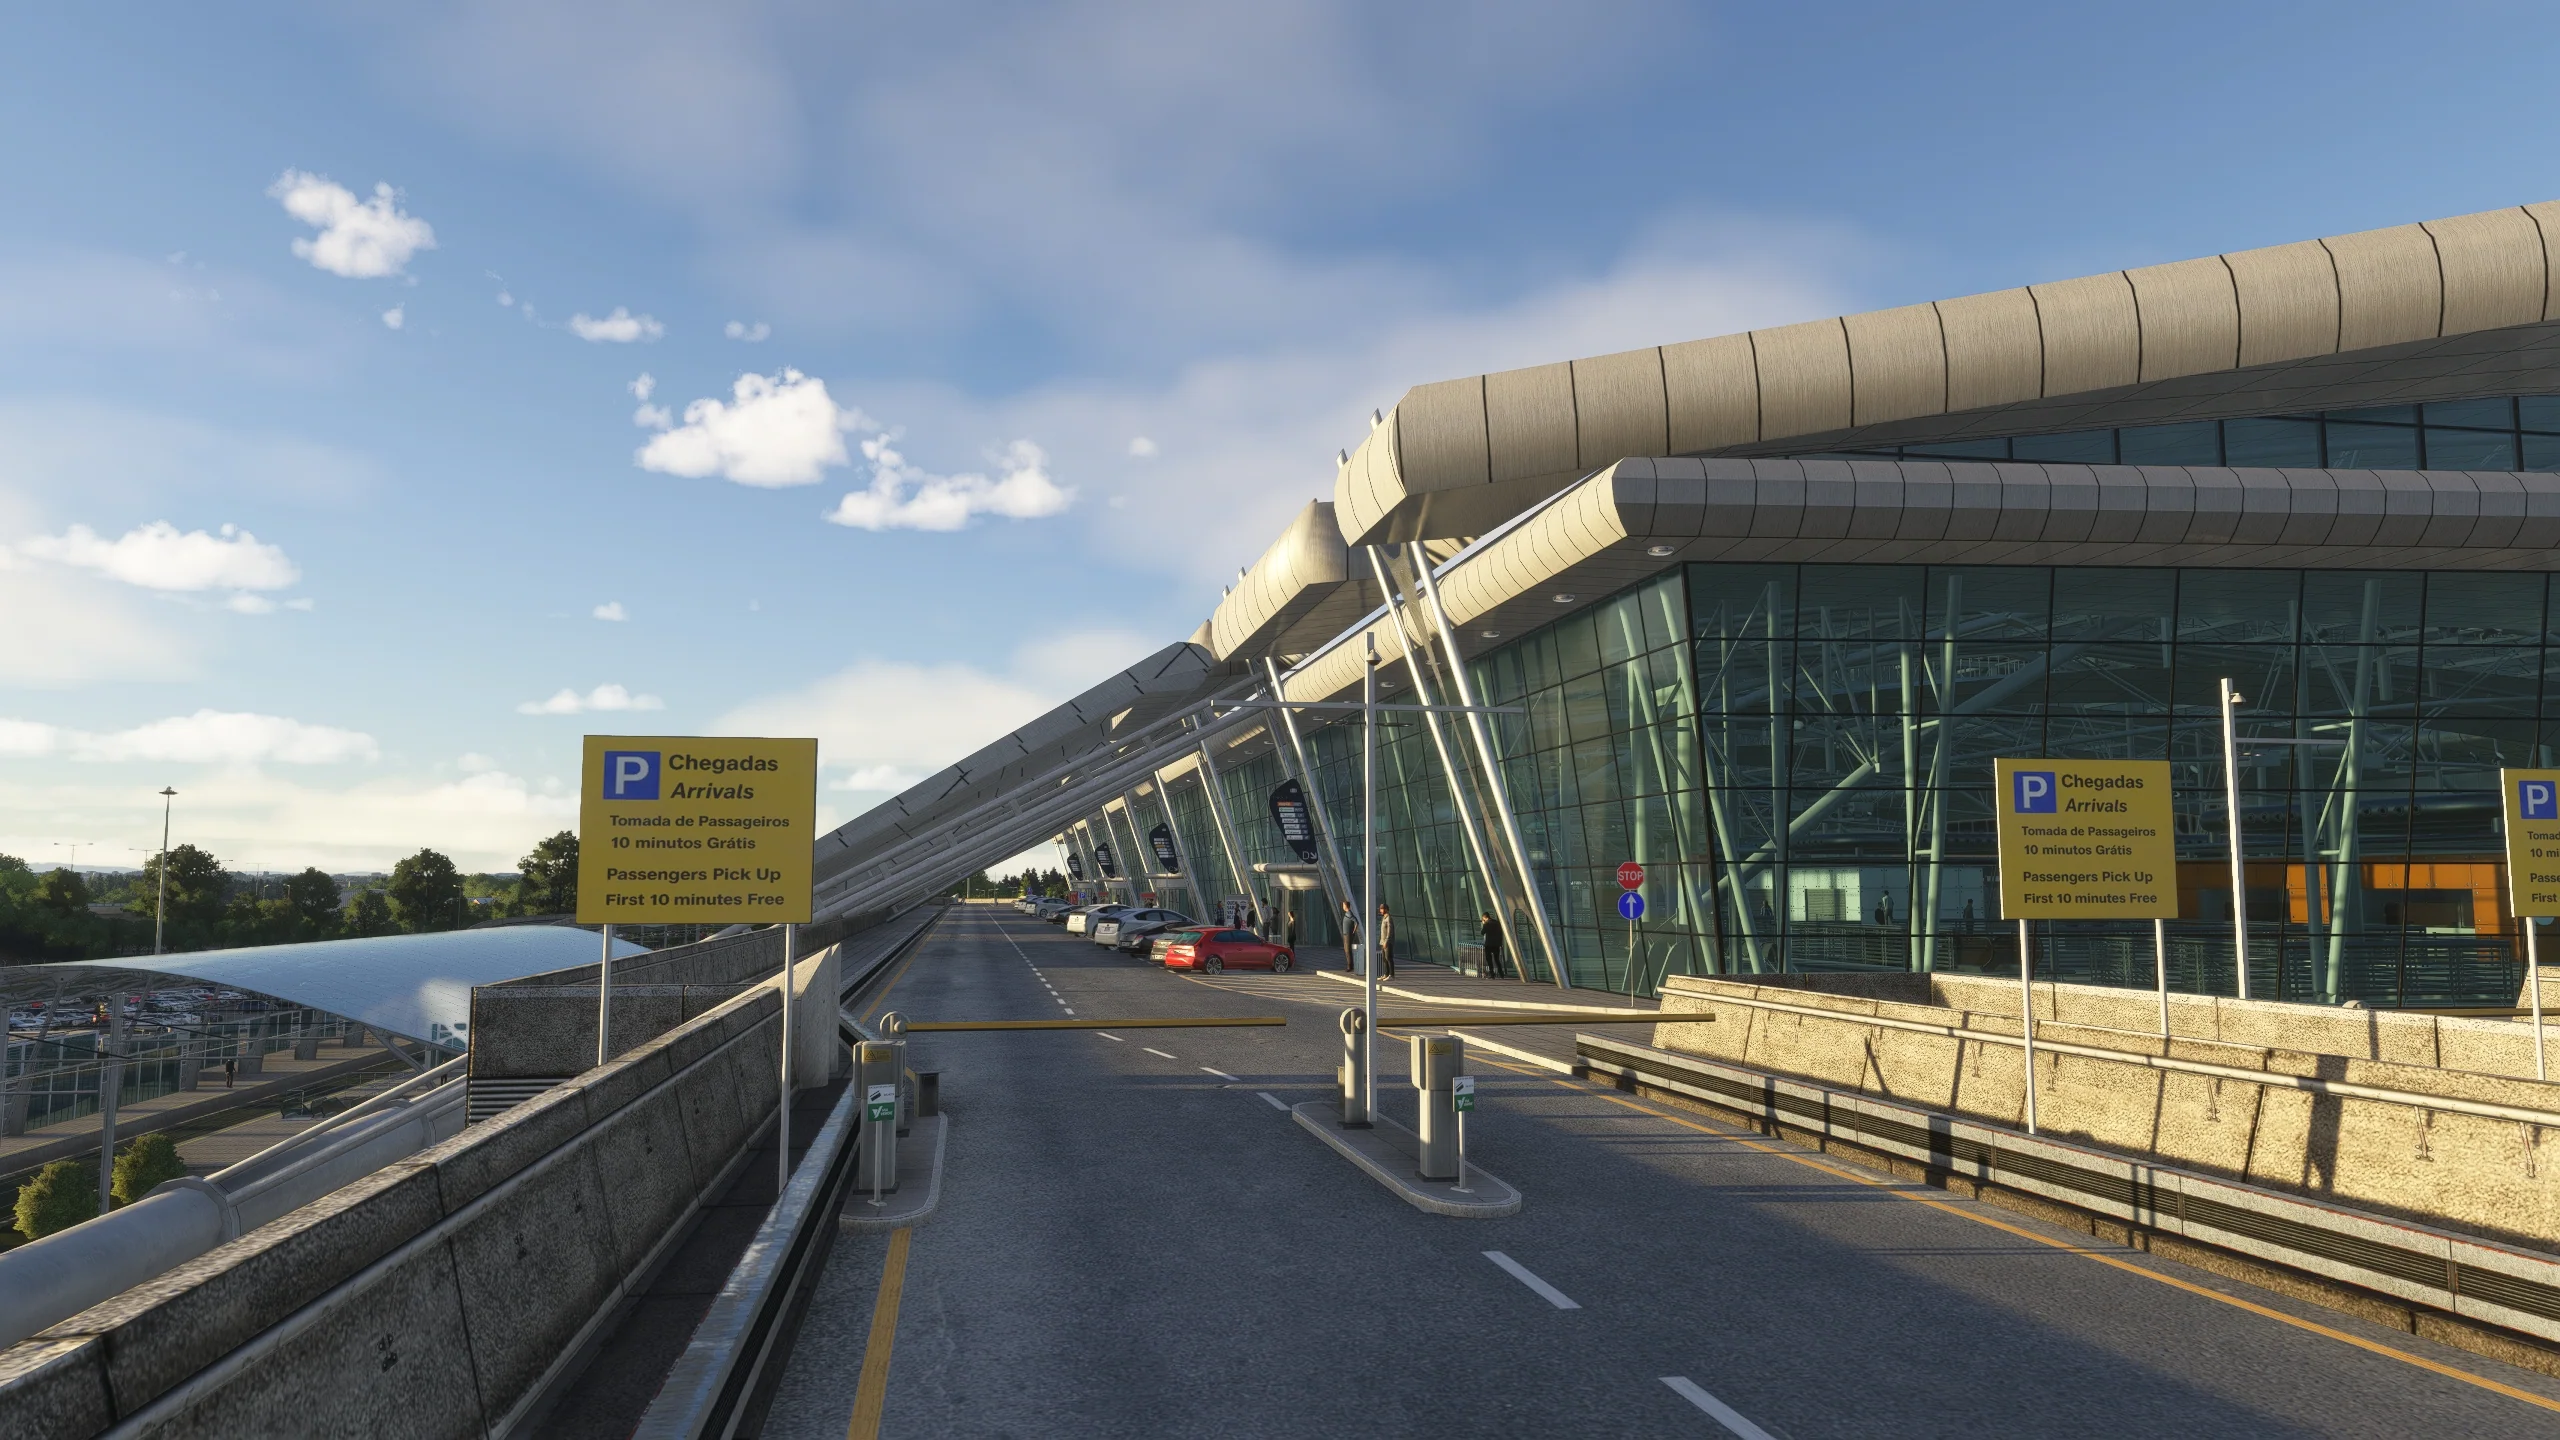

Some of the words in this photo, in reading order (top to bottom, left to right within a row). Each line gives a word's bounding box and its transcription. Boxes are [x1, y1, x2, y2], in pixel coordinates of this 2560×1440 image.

[668, 754, 779, 775] Chegadas
[615, 756, 649, 795] P
[2061, 774, 2144, 791] Chegadas
[670, 782, 754, 800] Arrivals
[2022, 775, 2048, 809] P
[2064, 798, 2128, 813] Arrivals
[2526, 784, 2549, 815] P
[609, 815, 671, 828] Tomada
[675, 815, 695, 828] de
[698, 816, 790, 830] Passageiros
[2021, 826, 2068, 836] Tomada
[2070, 826, 2085, 836] de
[2087, 827, 2156, 839] Passageiros
[611, 837, 630, 849] 10
[635, 837, 702, 850] minutos
[706, 836, 756, 850] Grátis
[2024, 844, 2039, 855] 10
[2042, 844, 2093, 856] minutos
[2095, 844, 2133, 856] Grátis
[2530, 847, 2543, 858] 10
[606, 867, 707, 884] Passengers
[712, 868, 752, 881] Pick
[756, 868, 782, 884] Up
[1618, 870, 1644, 881] STOP
[2023, 871, 2098, 885] Passengers
[2102, 871, 2131, 882] Pick
[2134, 871, 2154, 885] Up
[605, 894, 645, 906] First
[650, 894, 670, 906] 10
[674, 894, 743, 906] minutes
[747, 894, 785, 906] Free
[2023, 893, 2054, 904] First
[2057, 893, 2072, 904] 10
[2074, 893, 2126, 904] minutes
[2129, 893, 2158, 904] Free
[2531, 892, 2558, 903] First
